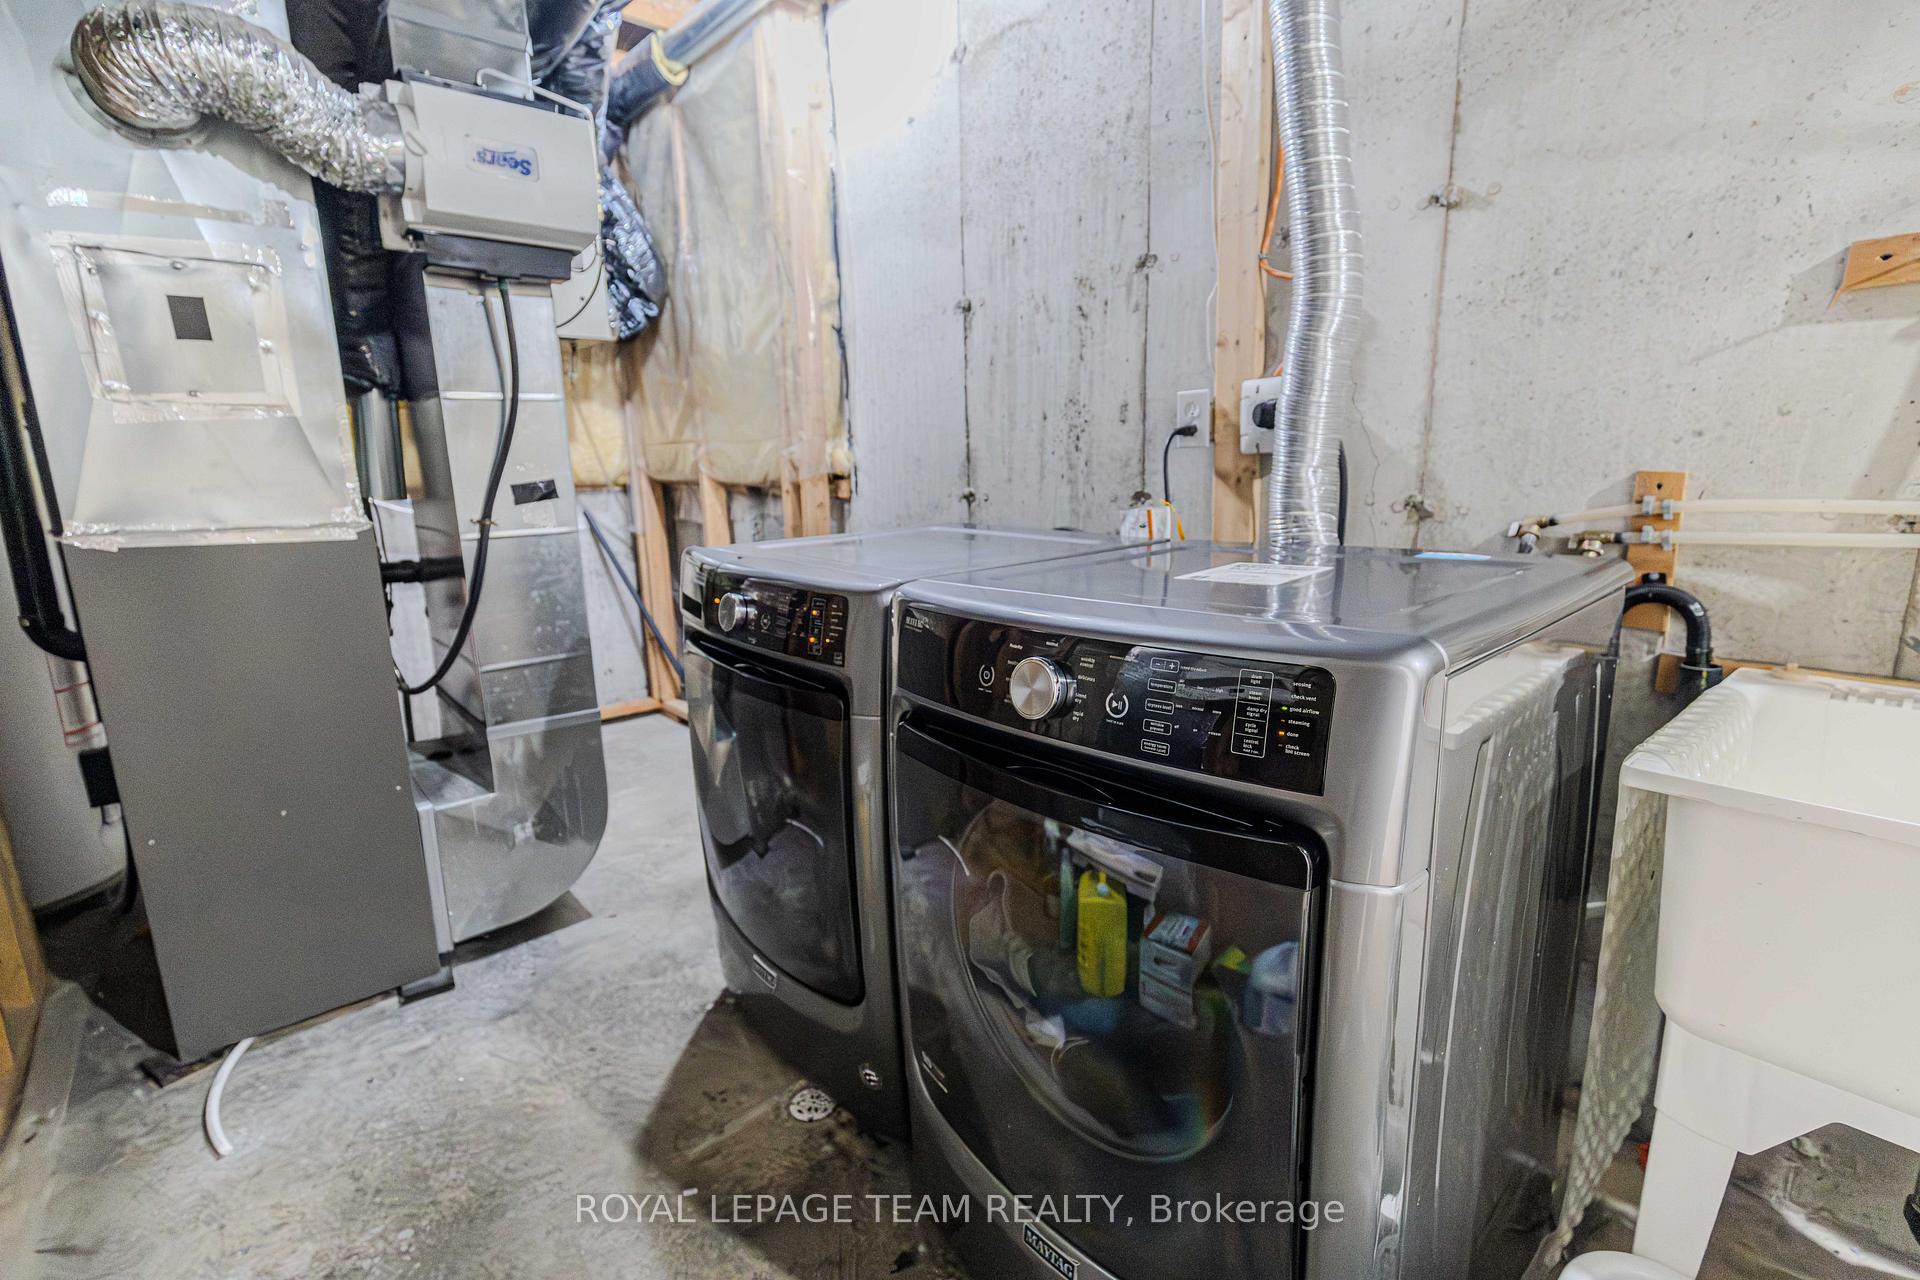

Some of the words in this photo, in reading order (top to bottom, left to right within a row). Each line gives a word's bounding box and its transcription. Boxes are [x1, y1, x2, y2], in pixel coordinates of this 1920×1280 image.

[475, 148, 532, 176] Sears
[1292, 681, 1312, 689] sensing
[1287, 719, 1311, 727] steaming
[1293, 750, 1311, 758] screen
[1025, 1230, 1074, 1278] MAYTAG
